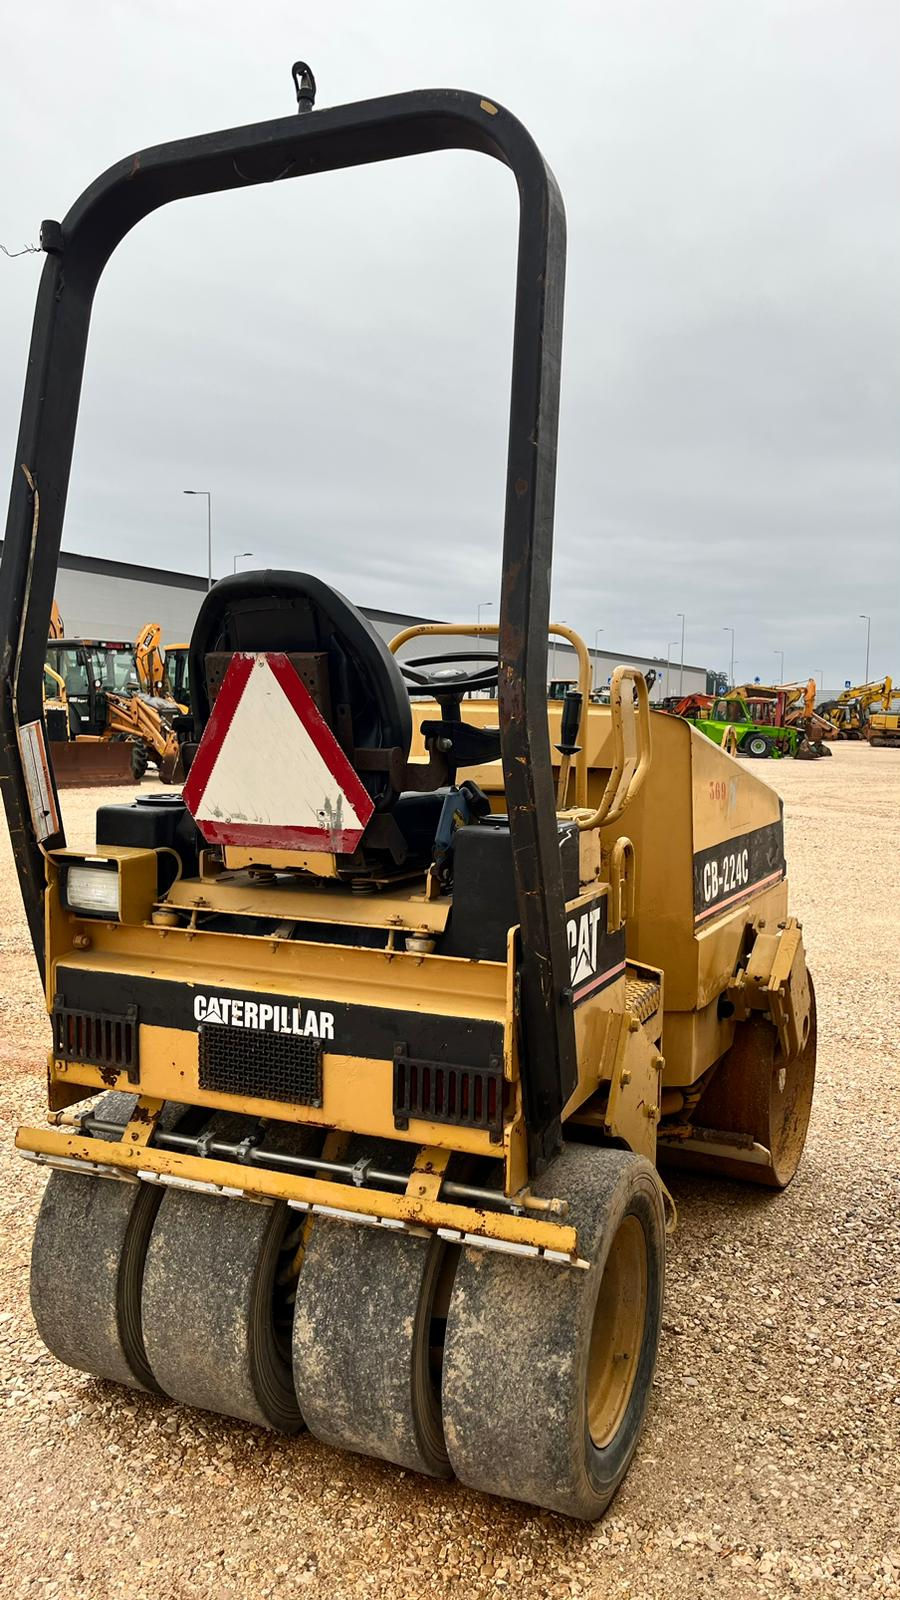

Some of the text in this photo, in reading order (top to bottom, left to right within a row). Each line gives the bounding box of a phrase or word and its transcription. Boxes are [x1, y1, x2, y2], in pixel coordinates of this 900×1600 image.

[703, 848, 748, 902] CB-224C
[566, 907, 601, 987] CAT
[193, 995, 335, 1040] CATERPILLAR
